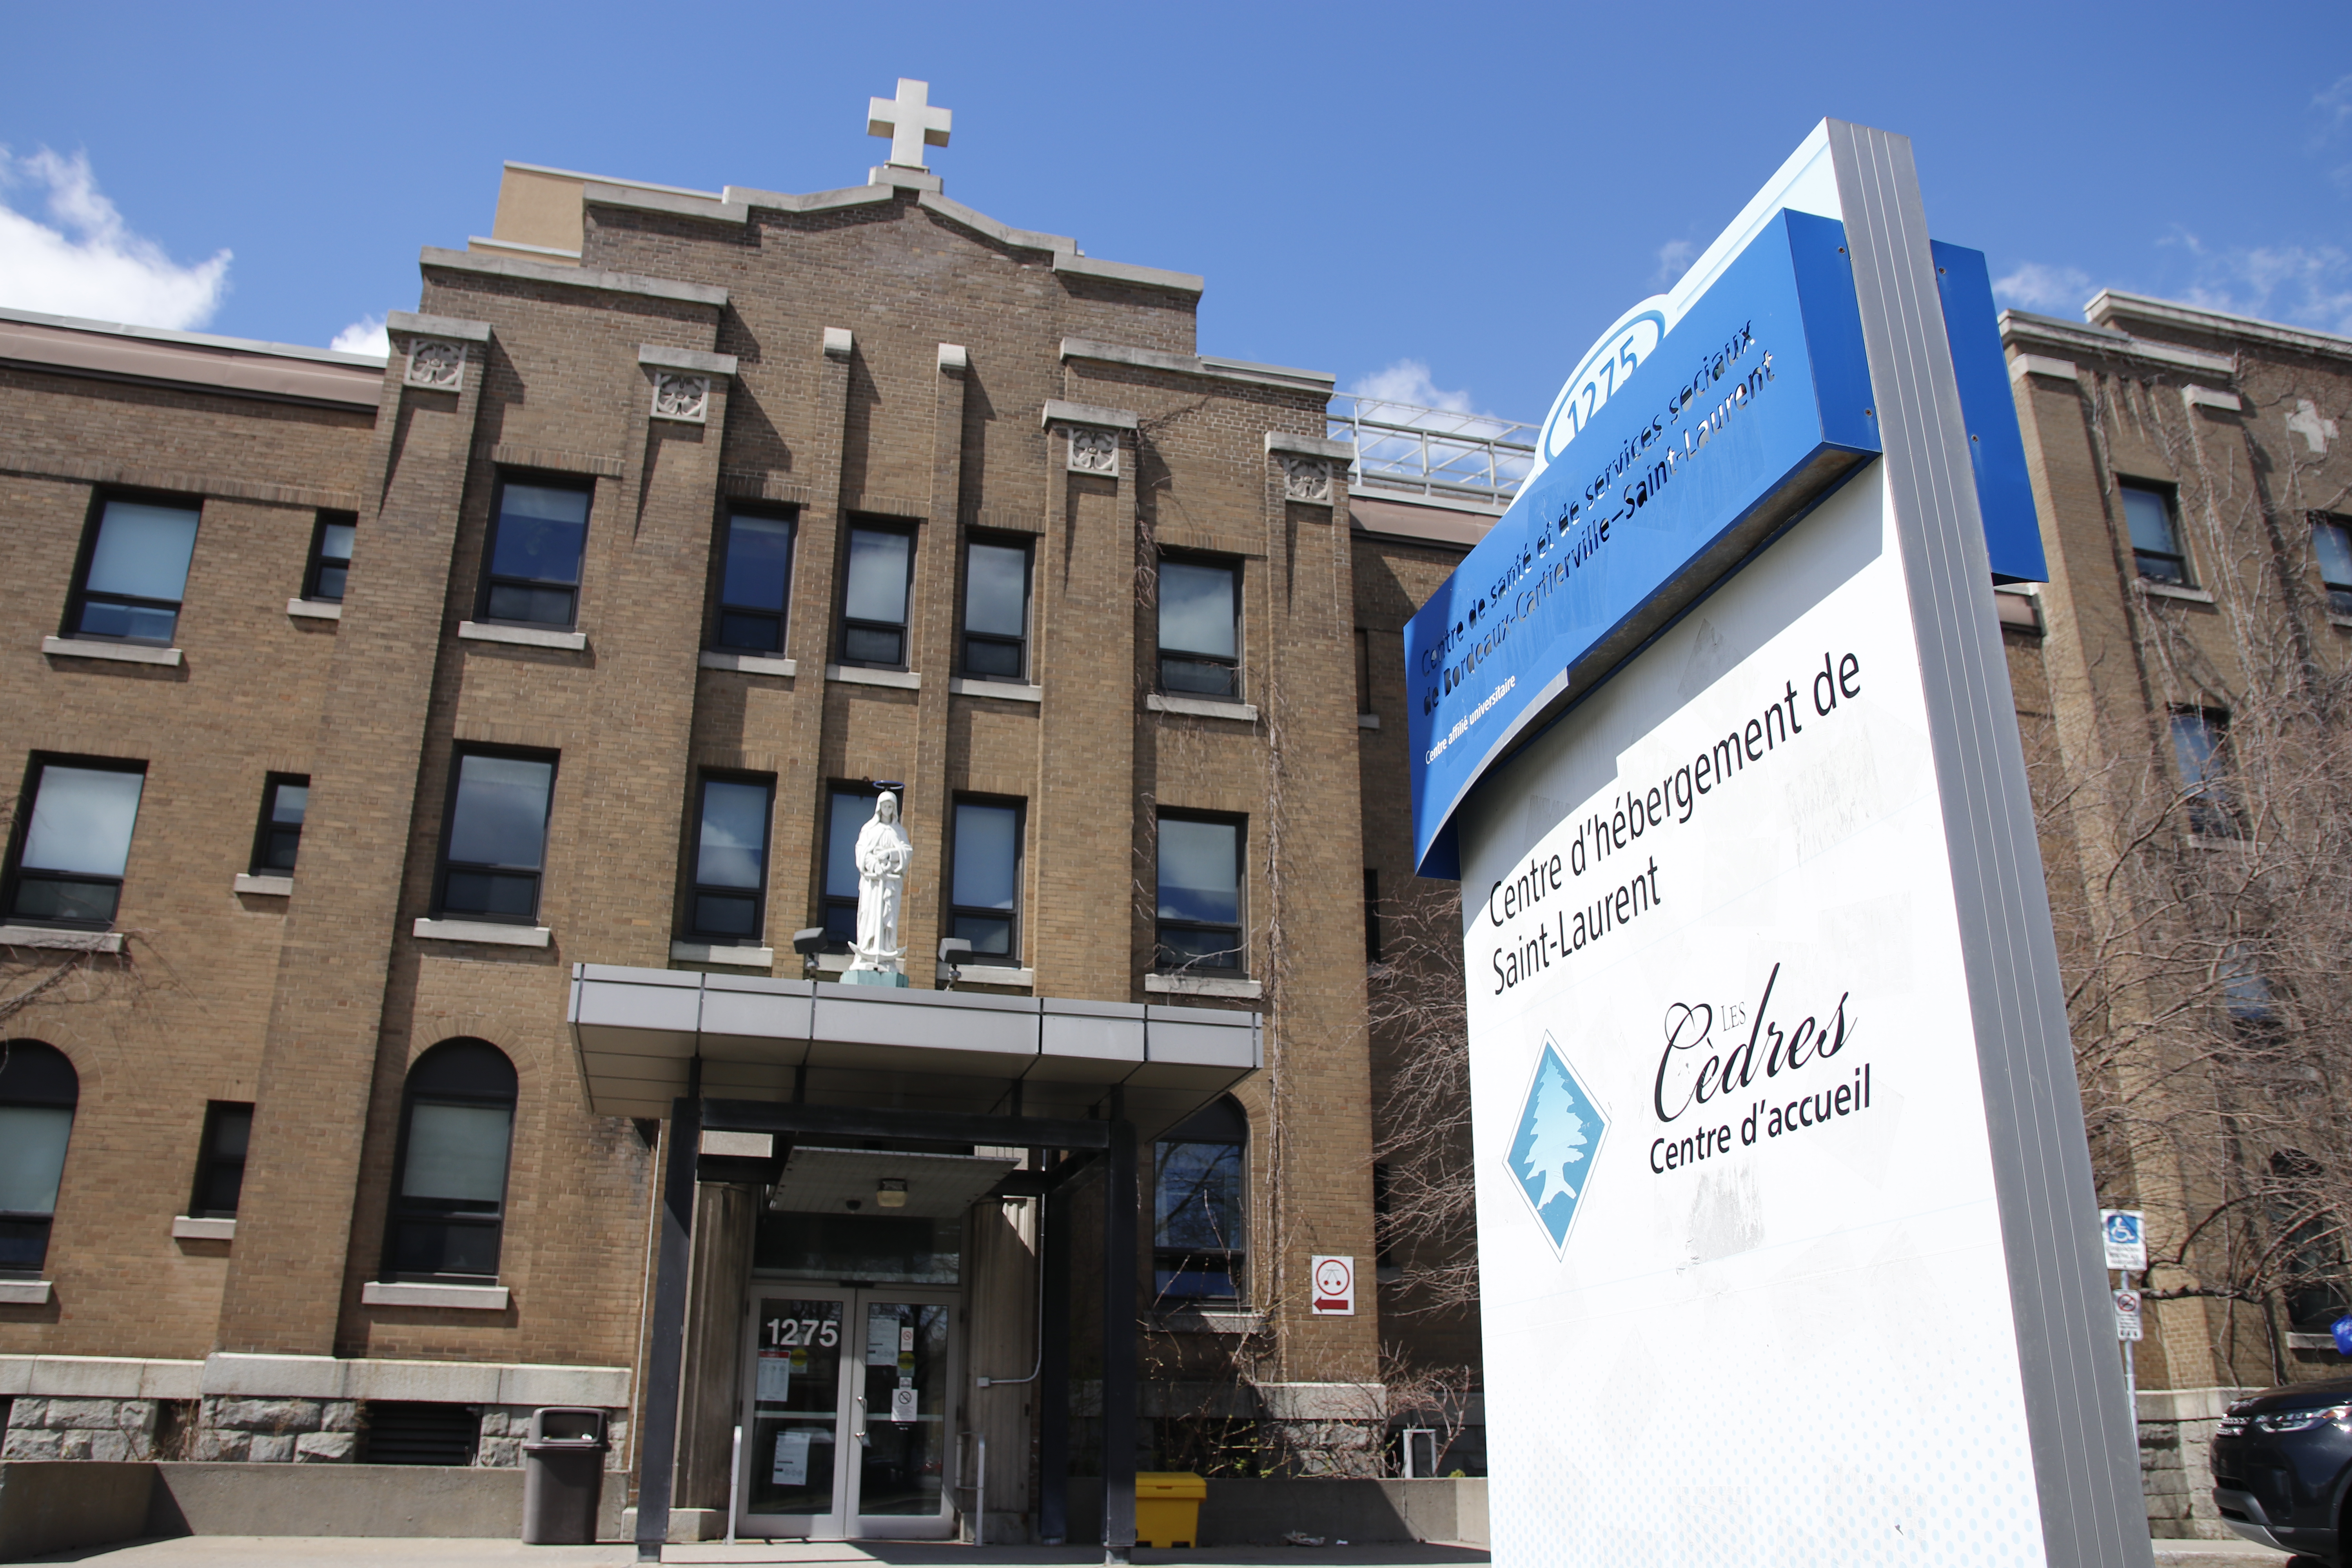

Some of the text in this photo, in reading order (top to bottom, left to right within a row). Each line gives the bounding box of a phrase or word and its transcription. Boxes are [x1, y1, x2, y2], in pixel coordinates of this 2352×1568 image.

[1567, 335, 1637, 436] 1275
[1422, 319, 1755, 677] Centre de santé et de services sociaux
[1423, 686, 1439, 716] de
[1425, 675, 1516, 765] Centre affilié universitaire
[1490, 652, 1861, 926] Centre d'hébergement de
[1493, 856, 1661, 995] Saint-Laurent
[1654, 962, 1858, 1123] Cèdres
[1650, 1063, 1870, 1174] Centre d'accueil
[767, 1318, 838, 1347] 1275
